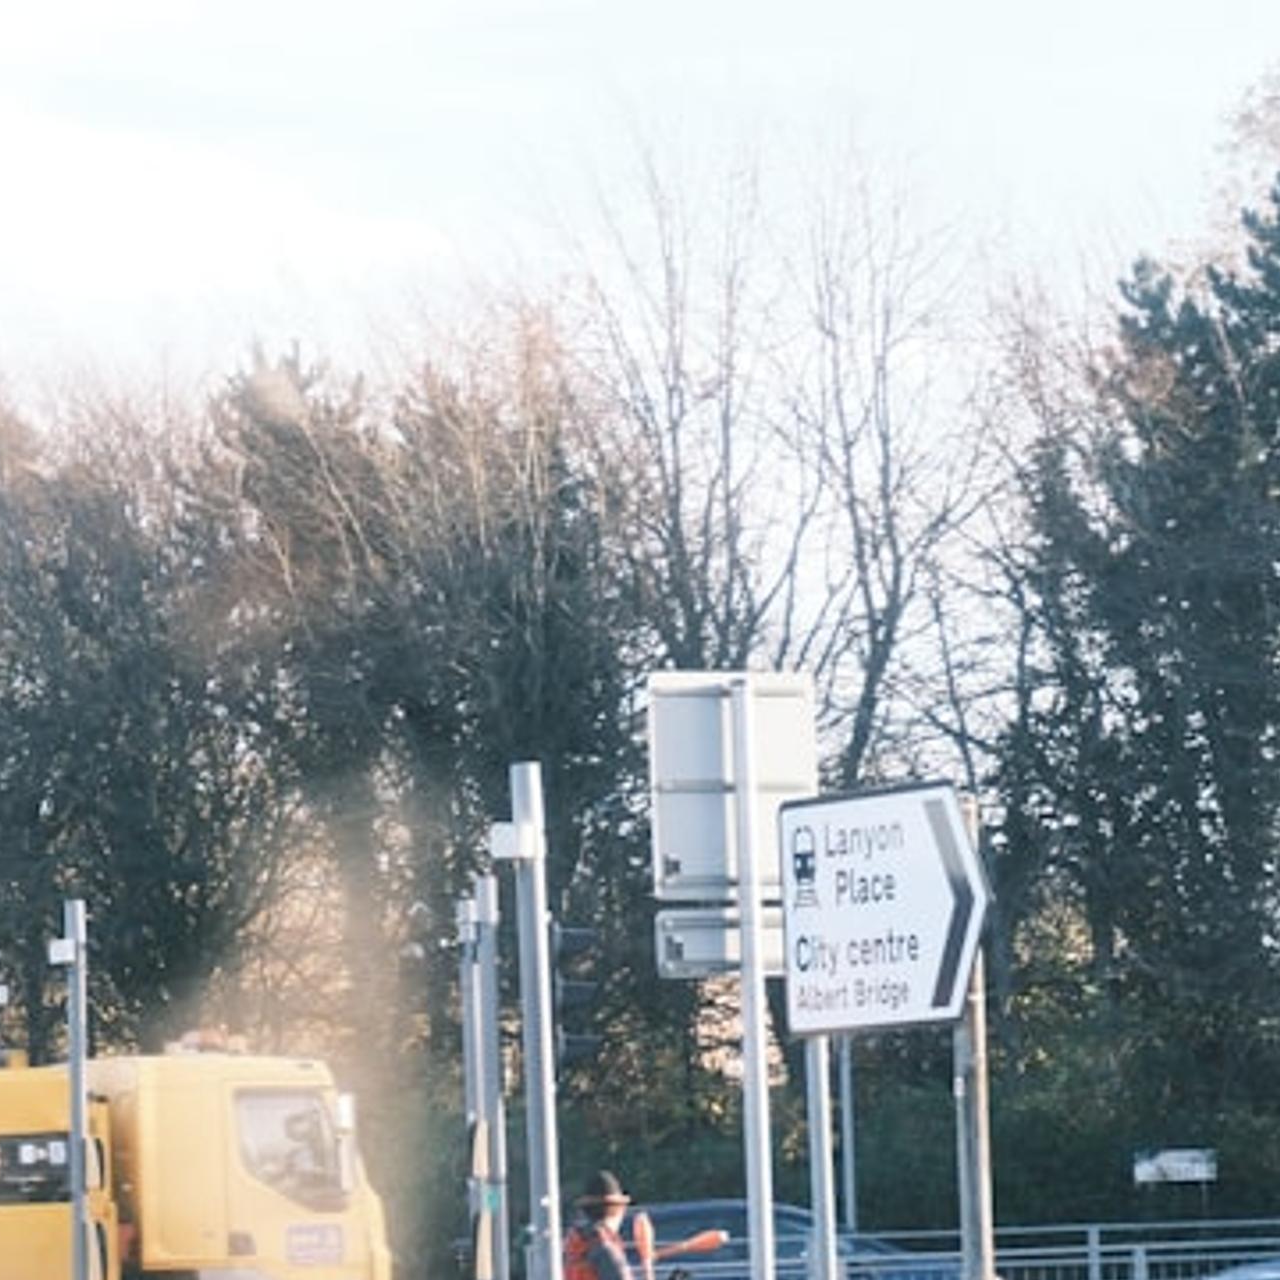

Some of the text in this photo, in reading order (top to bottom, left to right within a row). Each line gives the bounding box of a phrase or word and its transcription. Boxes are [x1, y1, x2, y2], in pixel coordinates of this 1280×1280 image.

[824, 823, 906, 859] Lanyon
[836, 869, 896, 906] Place
[847, 930, 920, 966] centre
